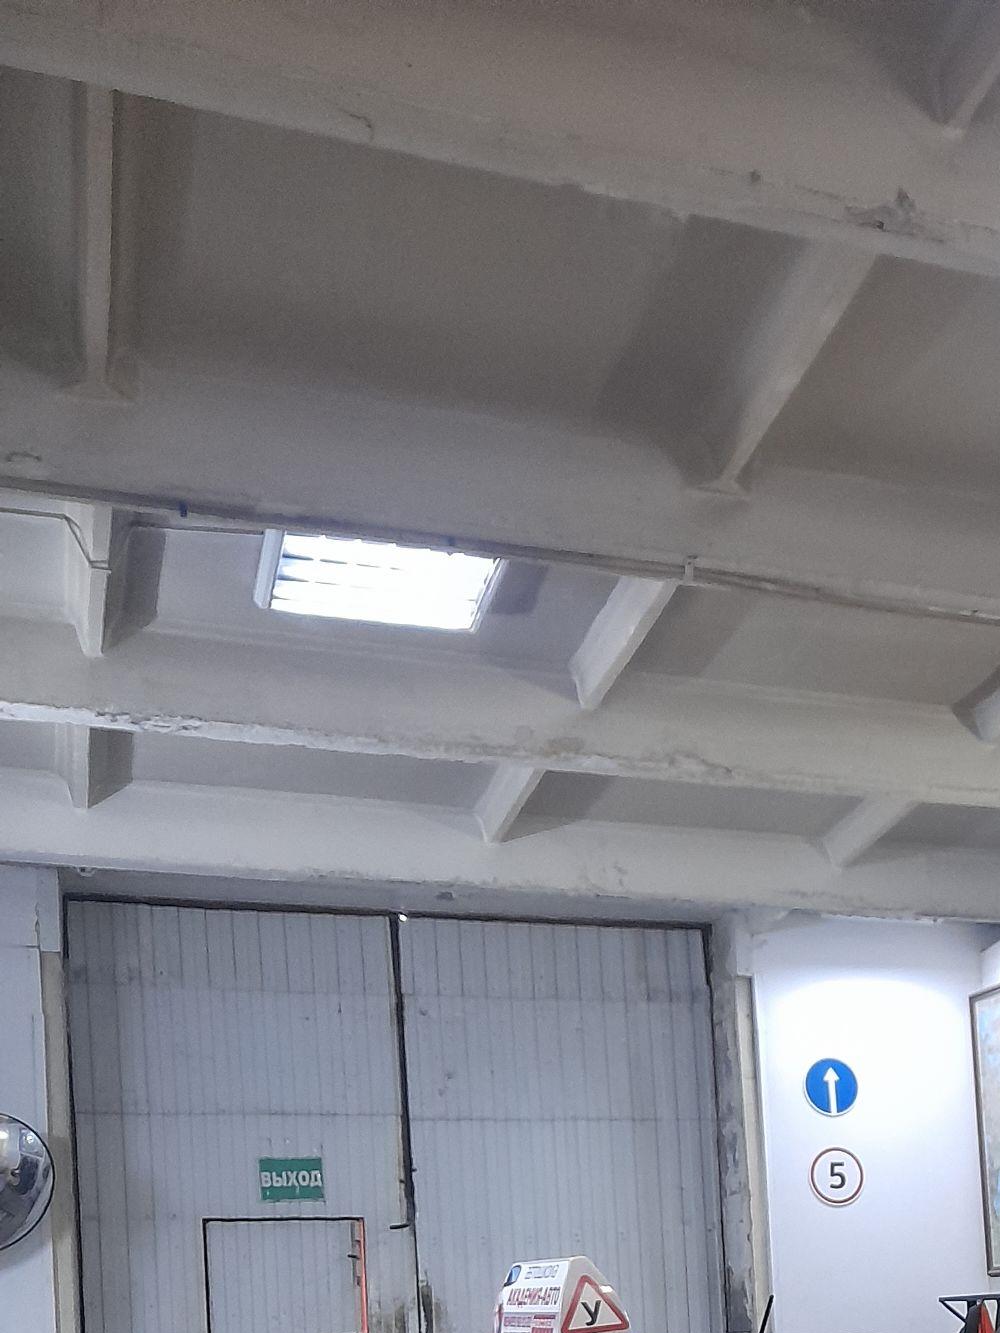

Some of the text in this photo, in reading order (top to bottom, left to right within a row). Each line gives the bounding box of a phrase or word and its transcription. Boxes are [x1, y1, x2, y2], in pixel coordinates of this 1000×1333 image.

[260, 1169, 323, 1188] ВЫХОД
[829, 1161, 847, 1190] 5
[580, 1300, 601, 1326] У
